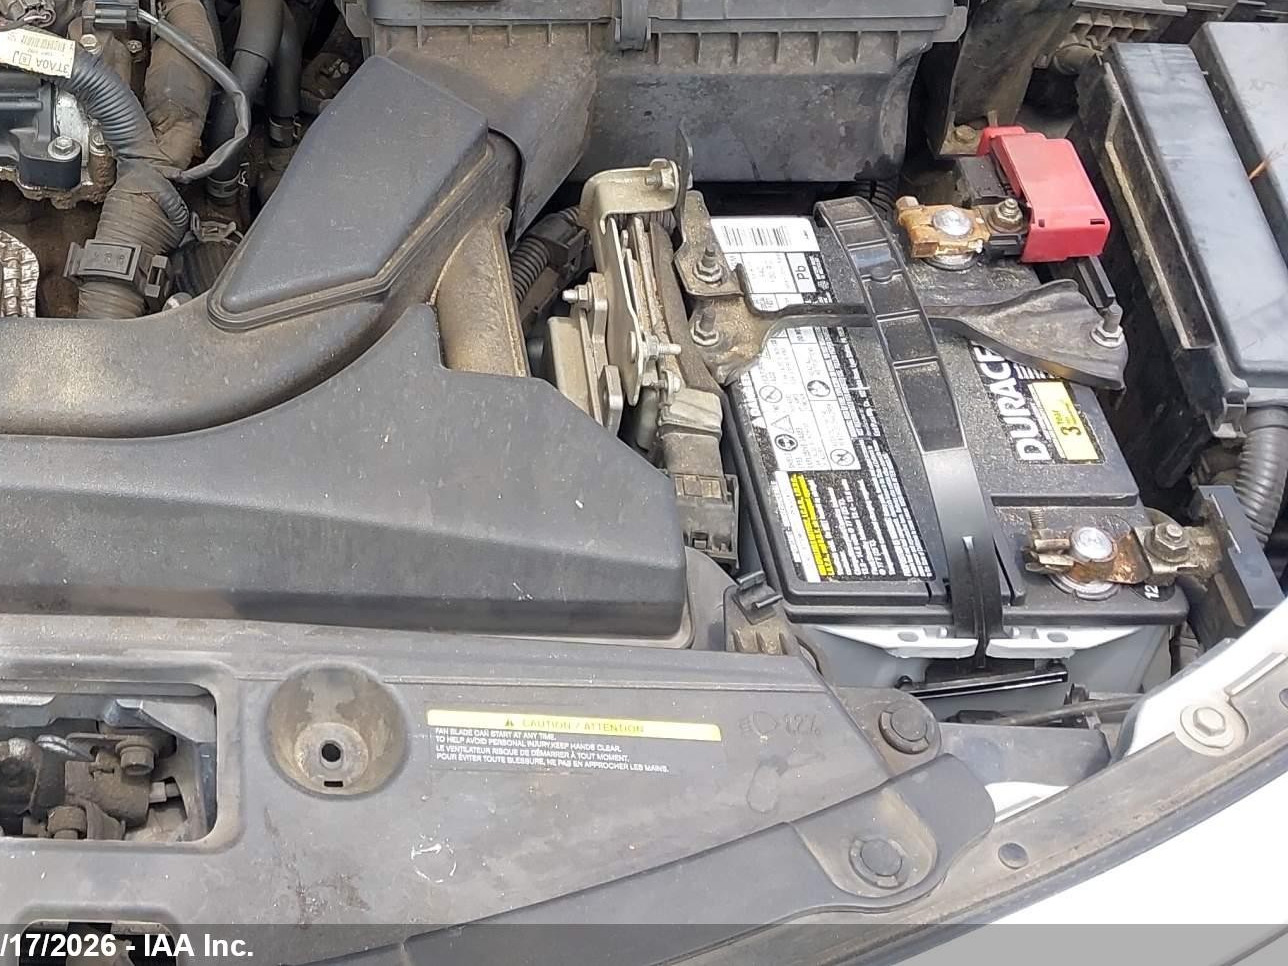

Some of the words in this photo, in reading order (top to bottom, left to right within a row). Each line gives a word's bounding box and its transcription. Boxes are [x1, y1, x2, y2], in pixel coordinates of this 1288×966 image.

[795, 265, 810, 280] Pb
[971, 340, 1052, 461] DURACE
[1060, 426, 1082, 436] 3
[584, 722, 644, 732] ATTENTION
